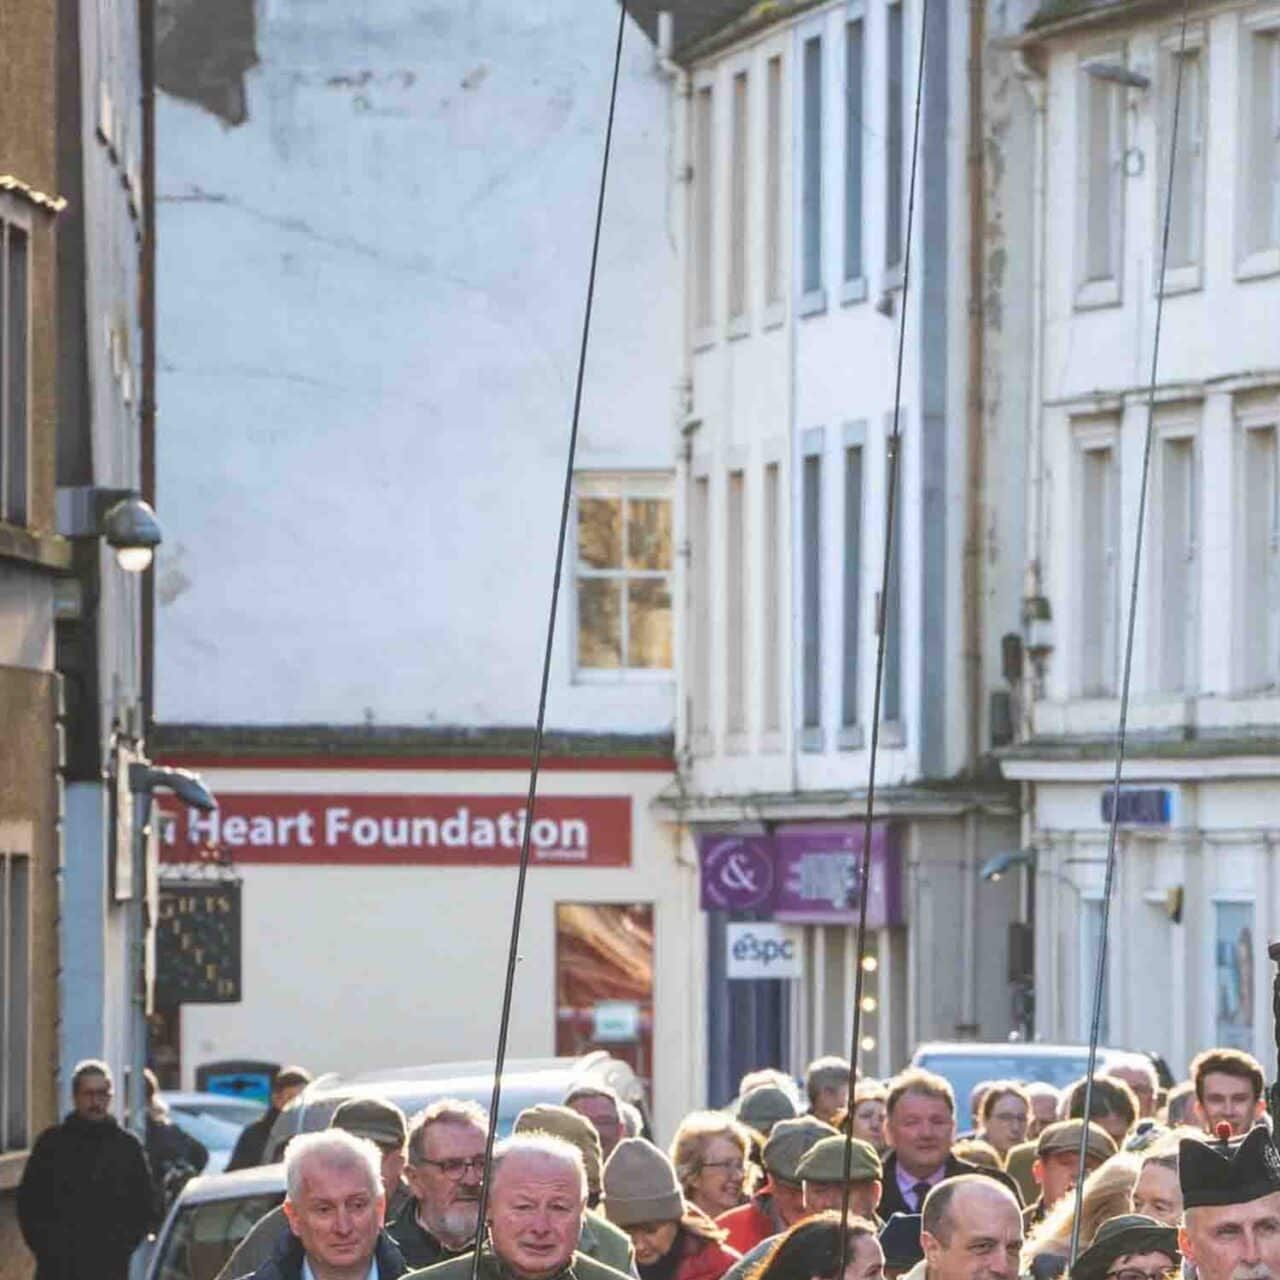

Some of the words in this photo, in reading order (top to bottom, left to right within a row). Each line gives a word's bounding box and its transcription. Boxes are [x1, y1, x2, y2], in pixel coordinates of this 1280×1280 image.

[188, 808, 315, 846] Heart
[325, 806, 588, 848] Foundation
[732, 932, 794, 968] espc
